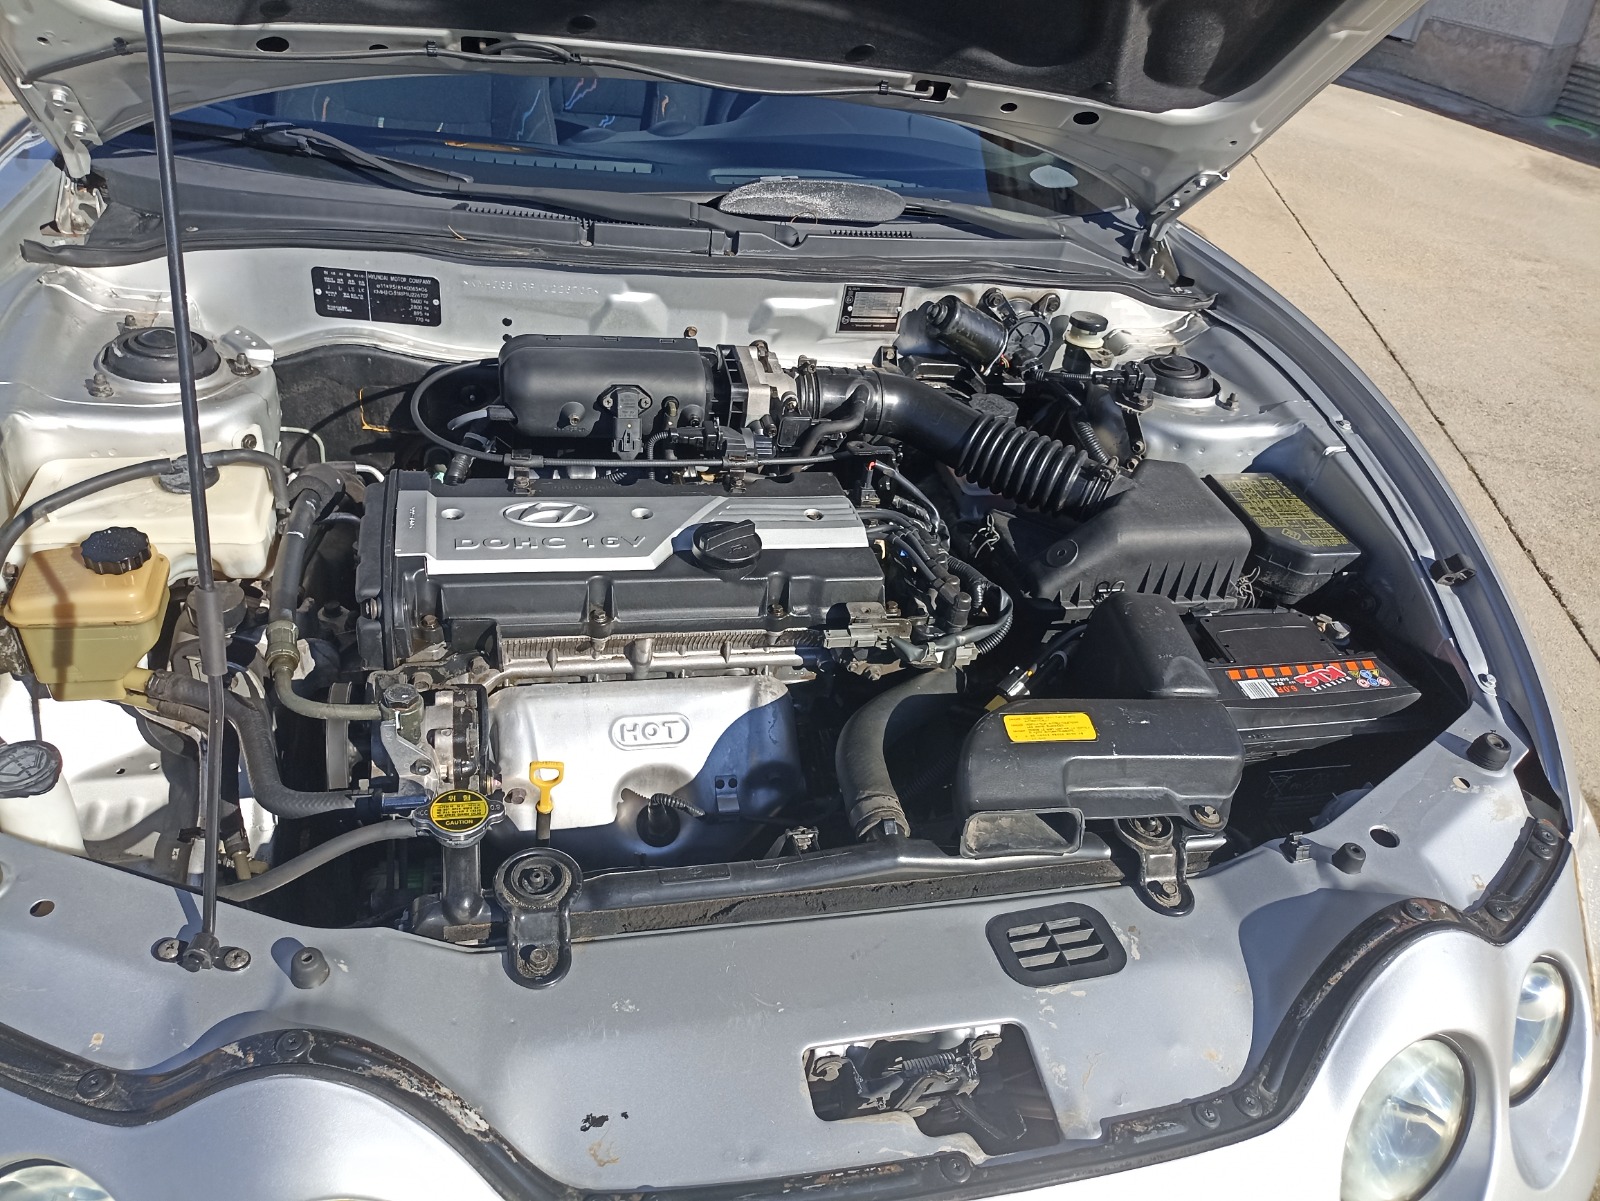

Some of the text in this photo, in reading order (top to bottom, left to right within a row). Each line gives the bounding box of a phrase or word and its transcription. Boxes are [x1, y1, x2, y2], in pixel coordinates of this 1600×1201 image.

[368, 273, 389, 281] HYUNDAI
[454, 535, 646, 550] DOHC 16V
[1311, 676, 1352, 692] BATERIAS
[619, 720, 680, 742] HOT
